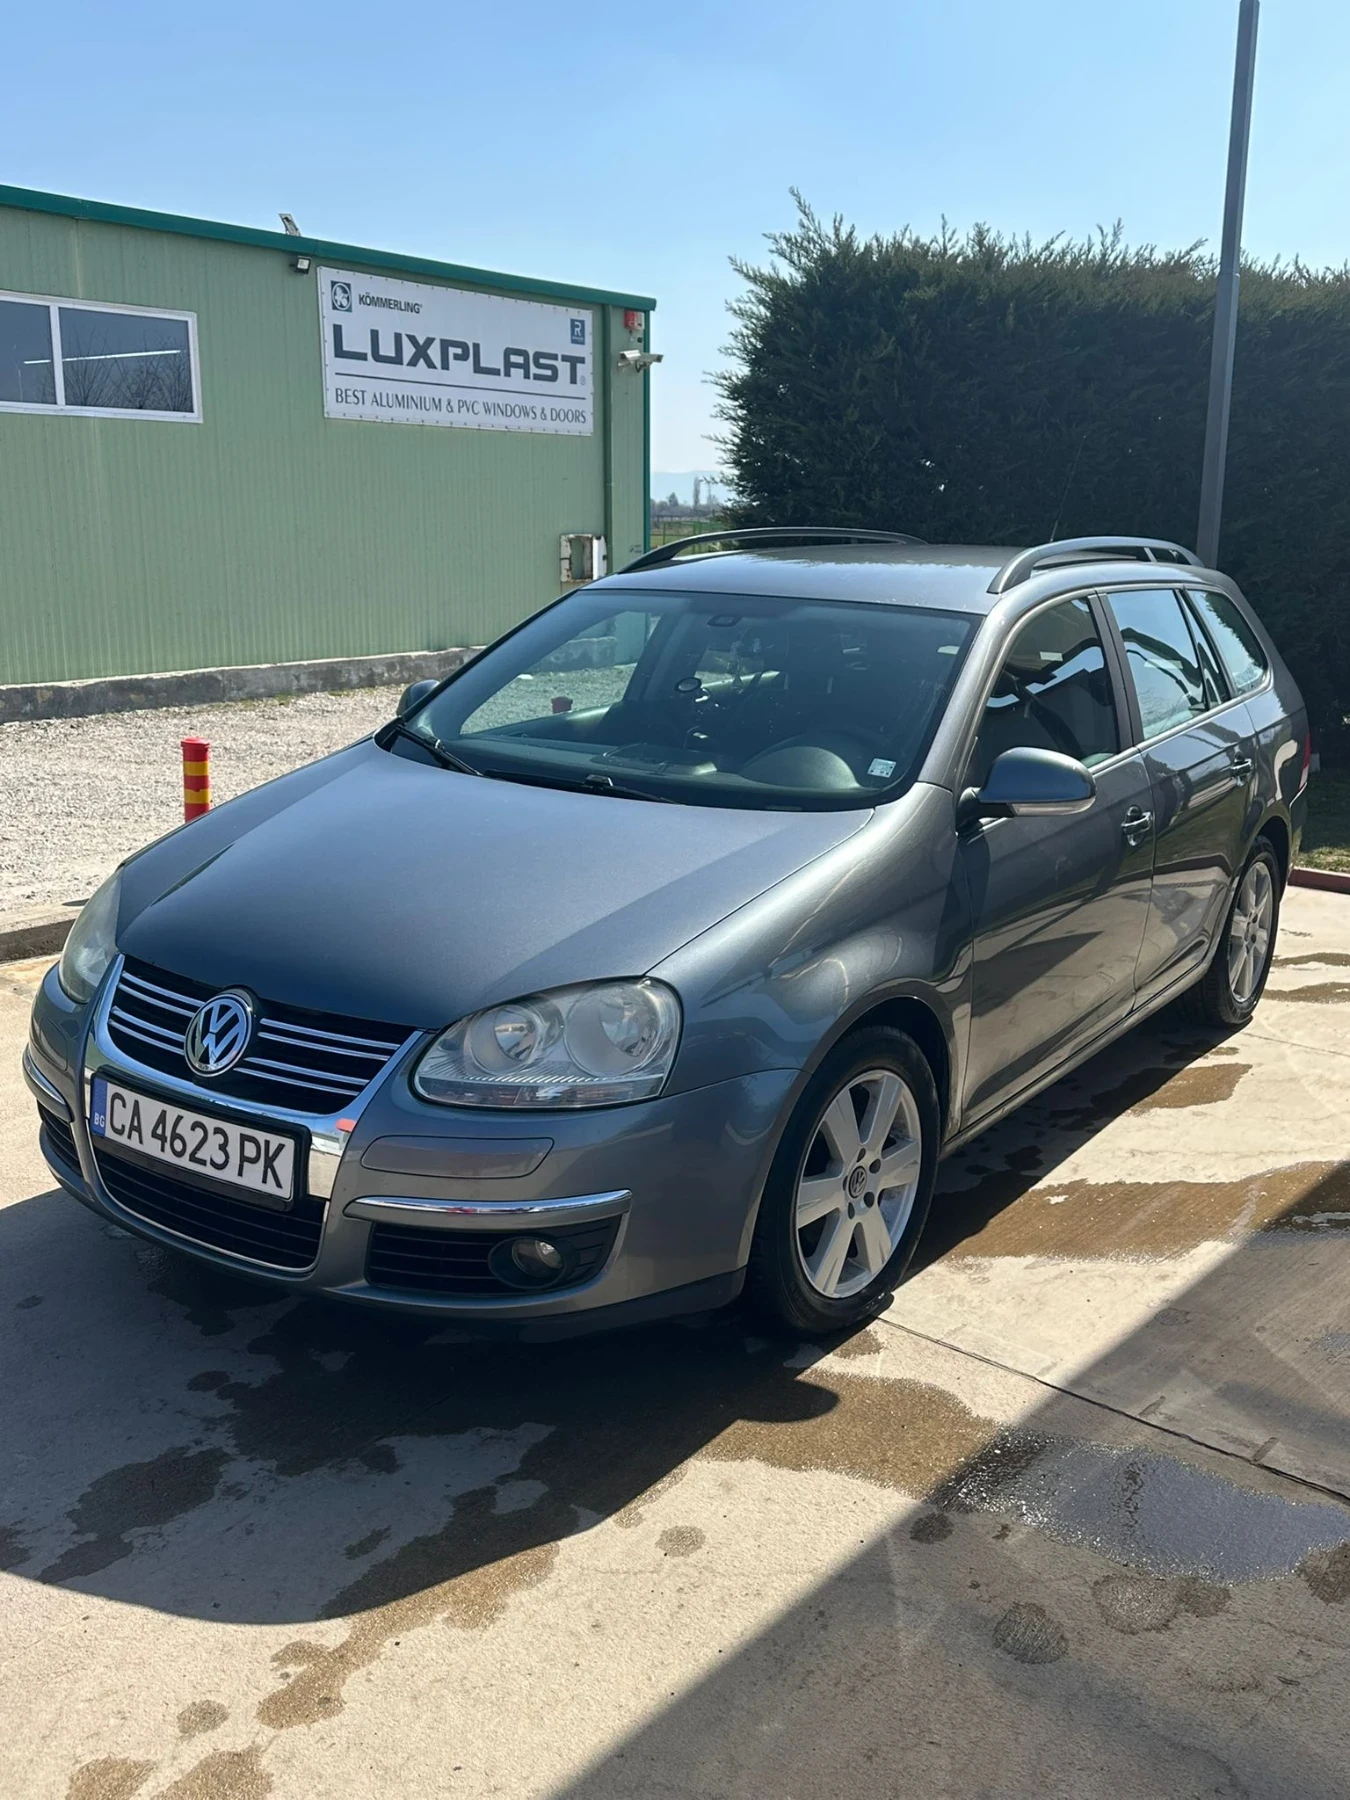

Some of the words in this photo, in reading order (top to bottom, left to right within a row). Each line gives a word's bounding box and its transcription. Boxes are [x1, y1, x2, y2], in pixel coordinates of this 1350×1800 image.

[335, 387, 367, 406] BEST
[371, 392, 442, 412] ALUMINIUM
[446, 398, 454, 413] &
[457, 399, 480, 415] PVC
[482, 401, 537, 420] WINDOWS
[540, 406, 547, 421] &
[550, 407, 587, 424] DOORS
[93, 1112, 105, 1128] BG
[109, 1091, 144, 1146] CA
[151, 1109, 230, 1171] 4623
[237, 1132, 286, 1190] PK
